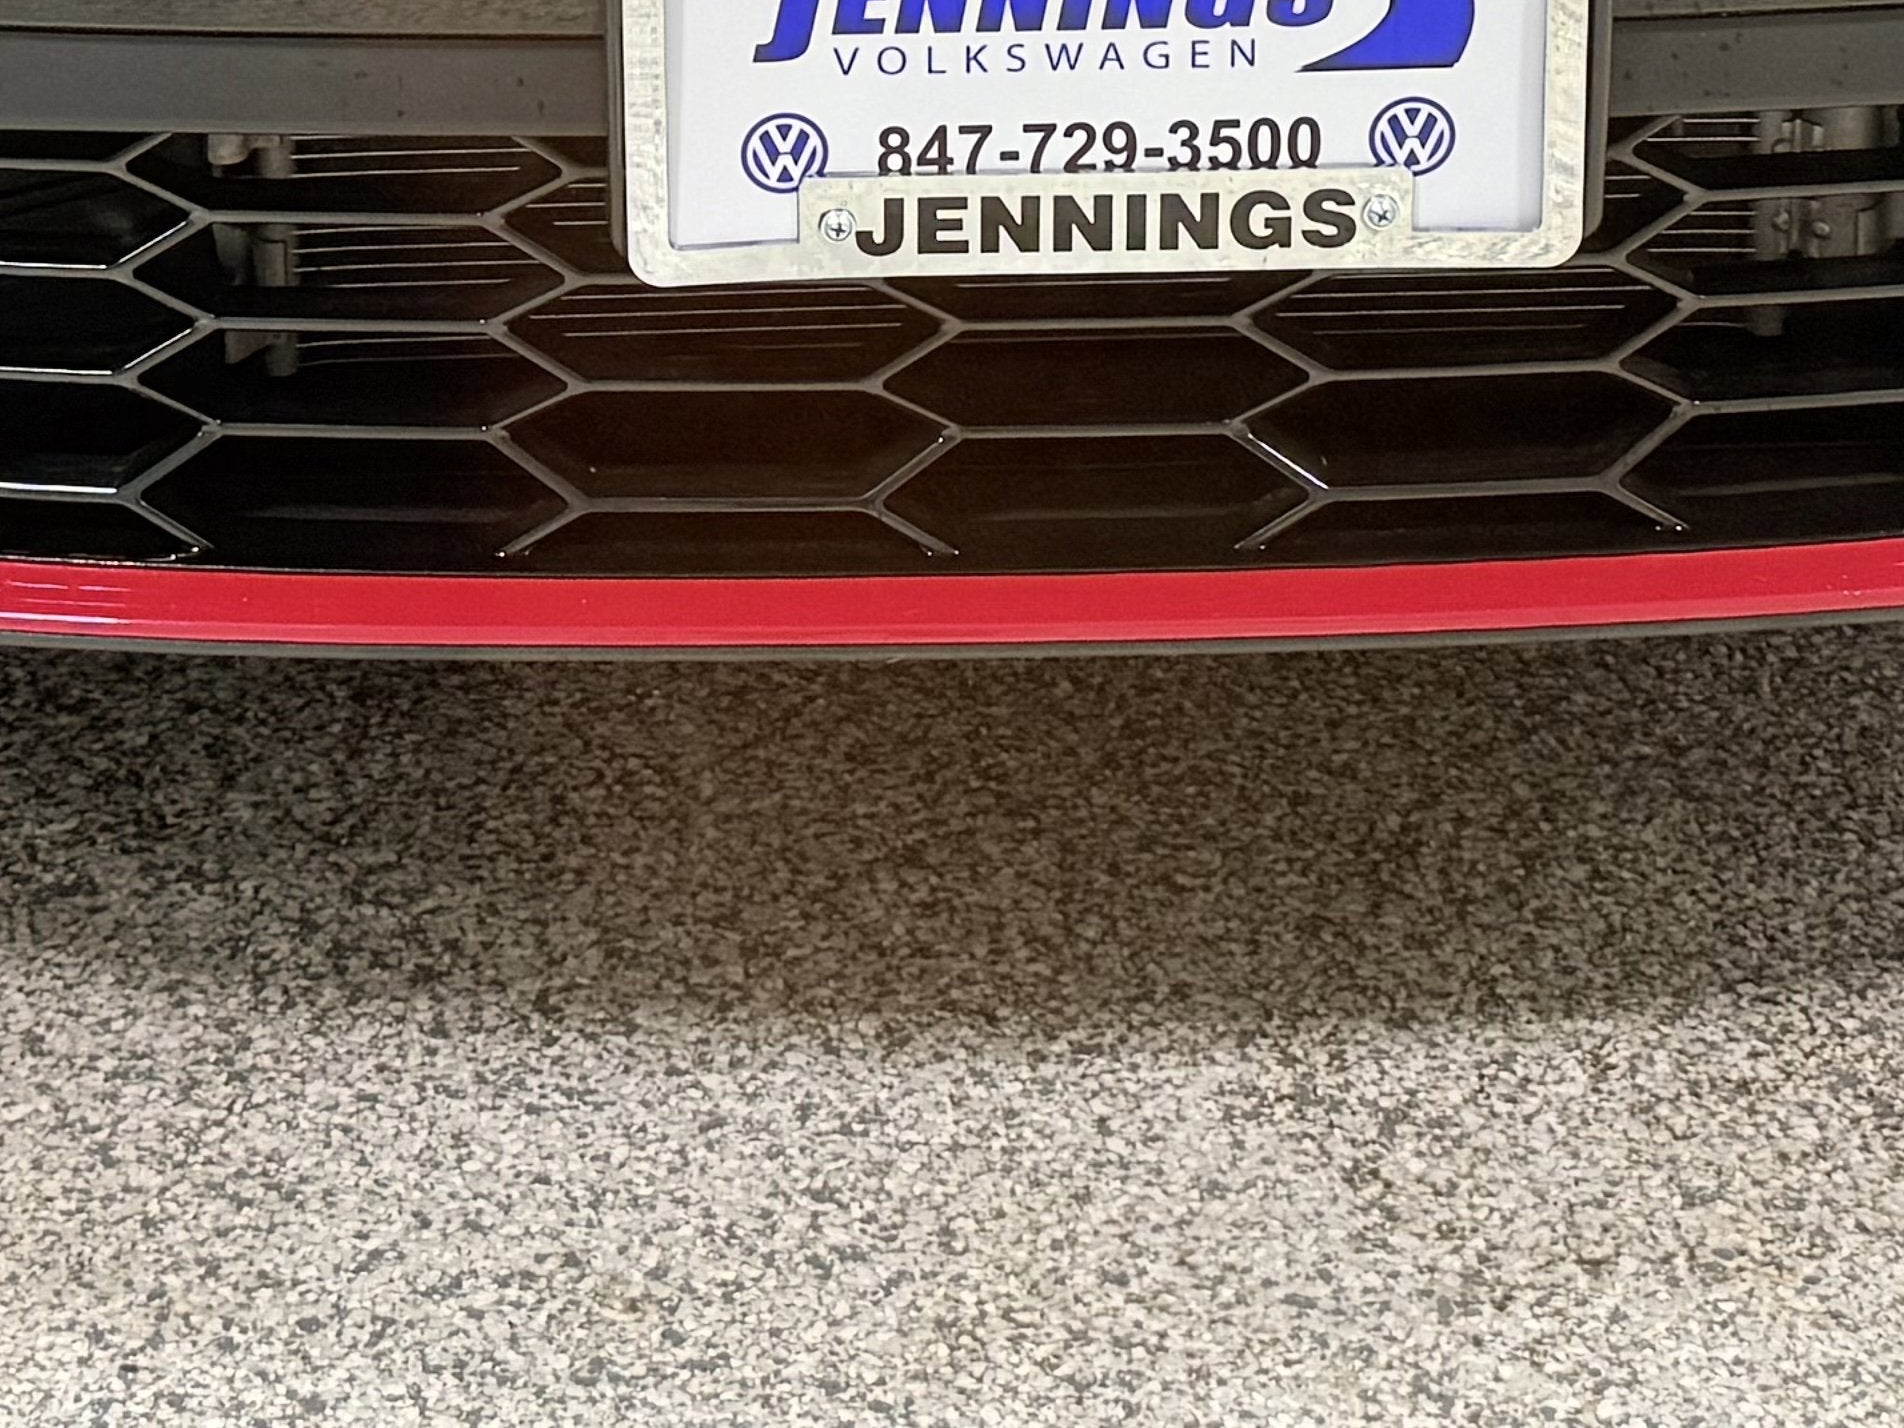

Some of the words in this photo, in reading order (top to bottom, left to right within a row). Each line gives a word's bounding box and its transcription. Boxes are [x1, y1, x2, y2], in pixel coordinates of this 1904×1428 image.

[833, 38, 1257, 76] VOLKSWAGEN
[877, 116, 1322, 175] 847-729-3500
[854, 187, 1357, 256] JENNINGS
